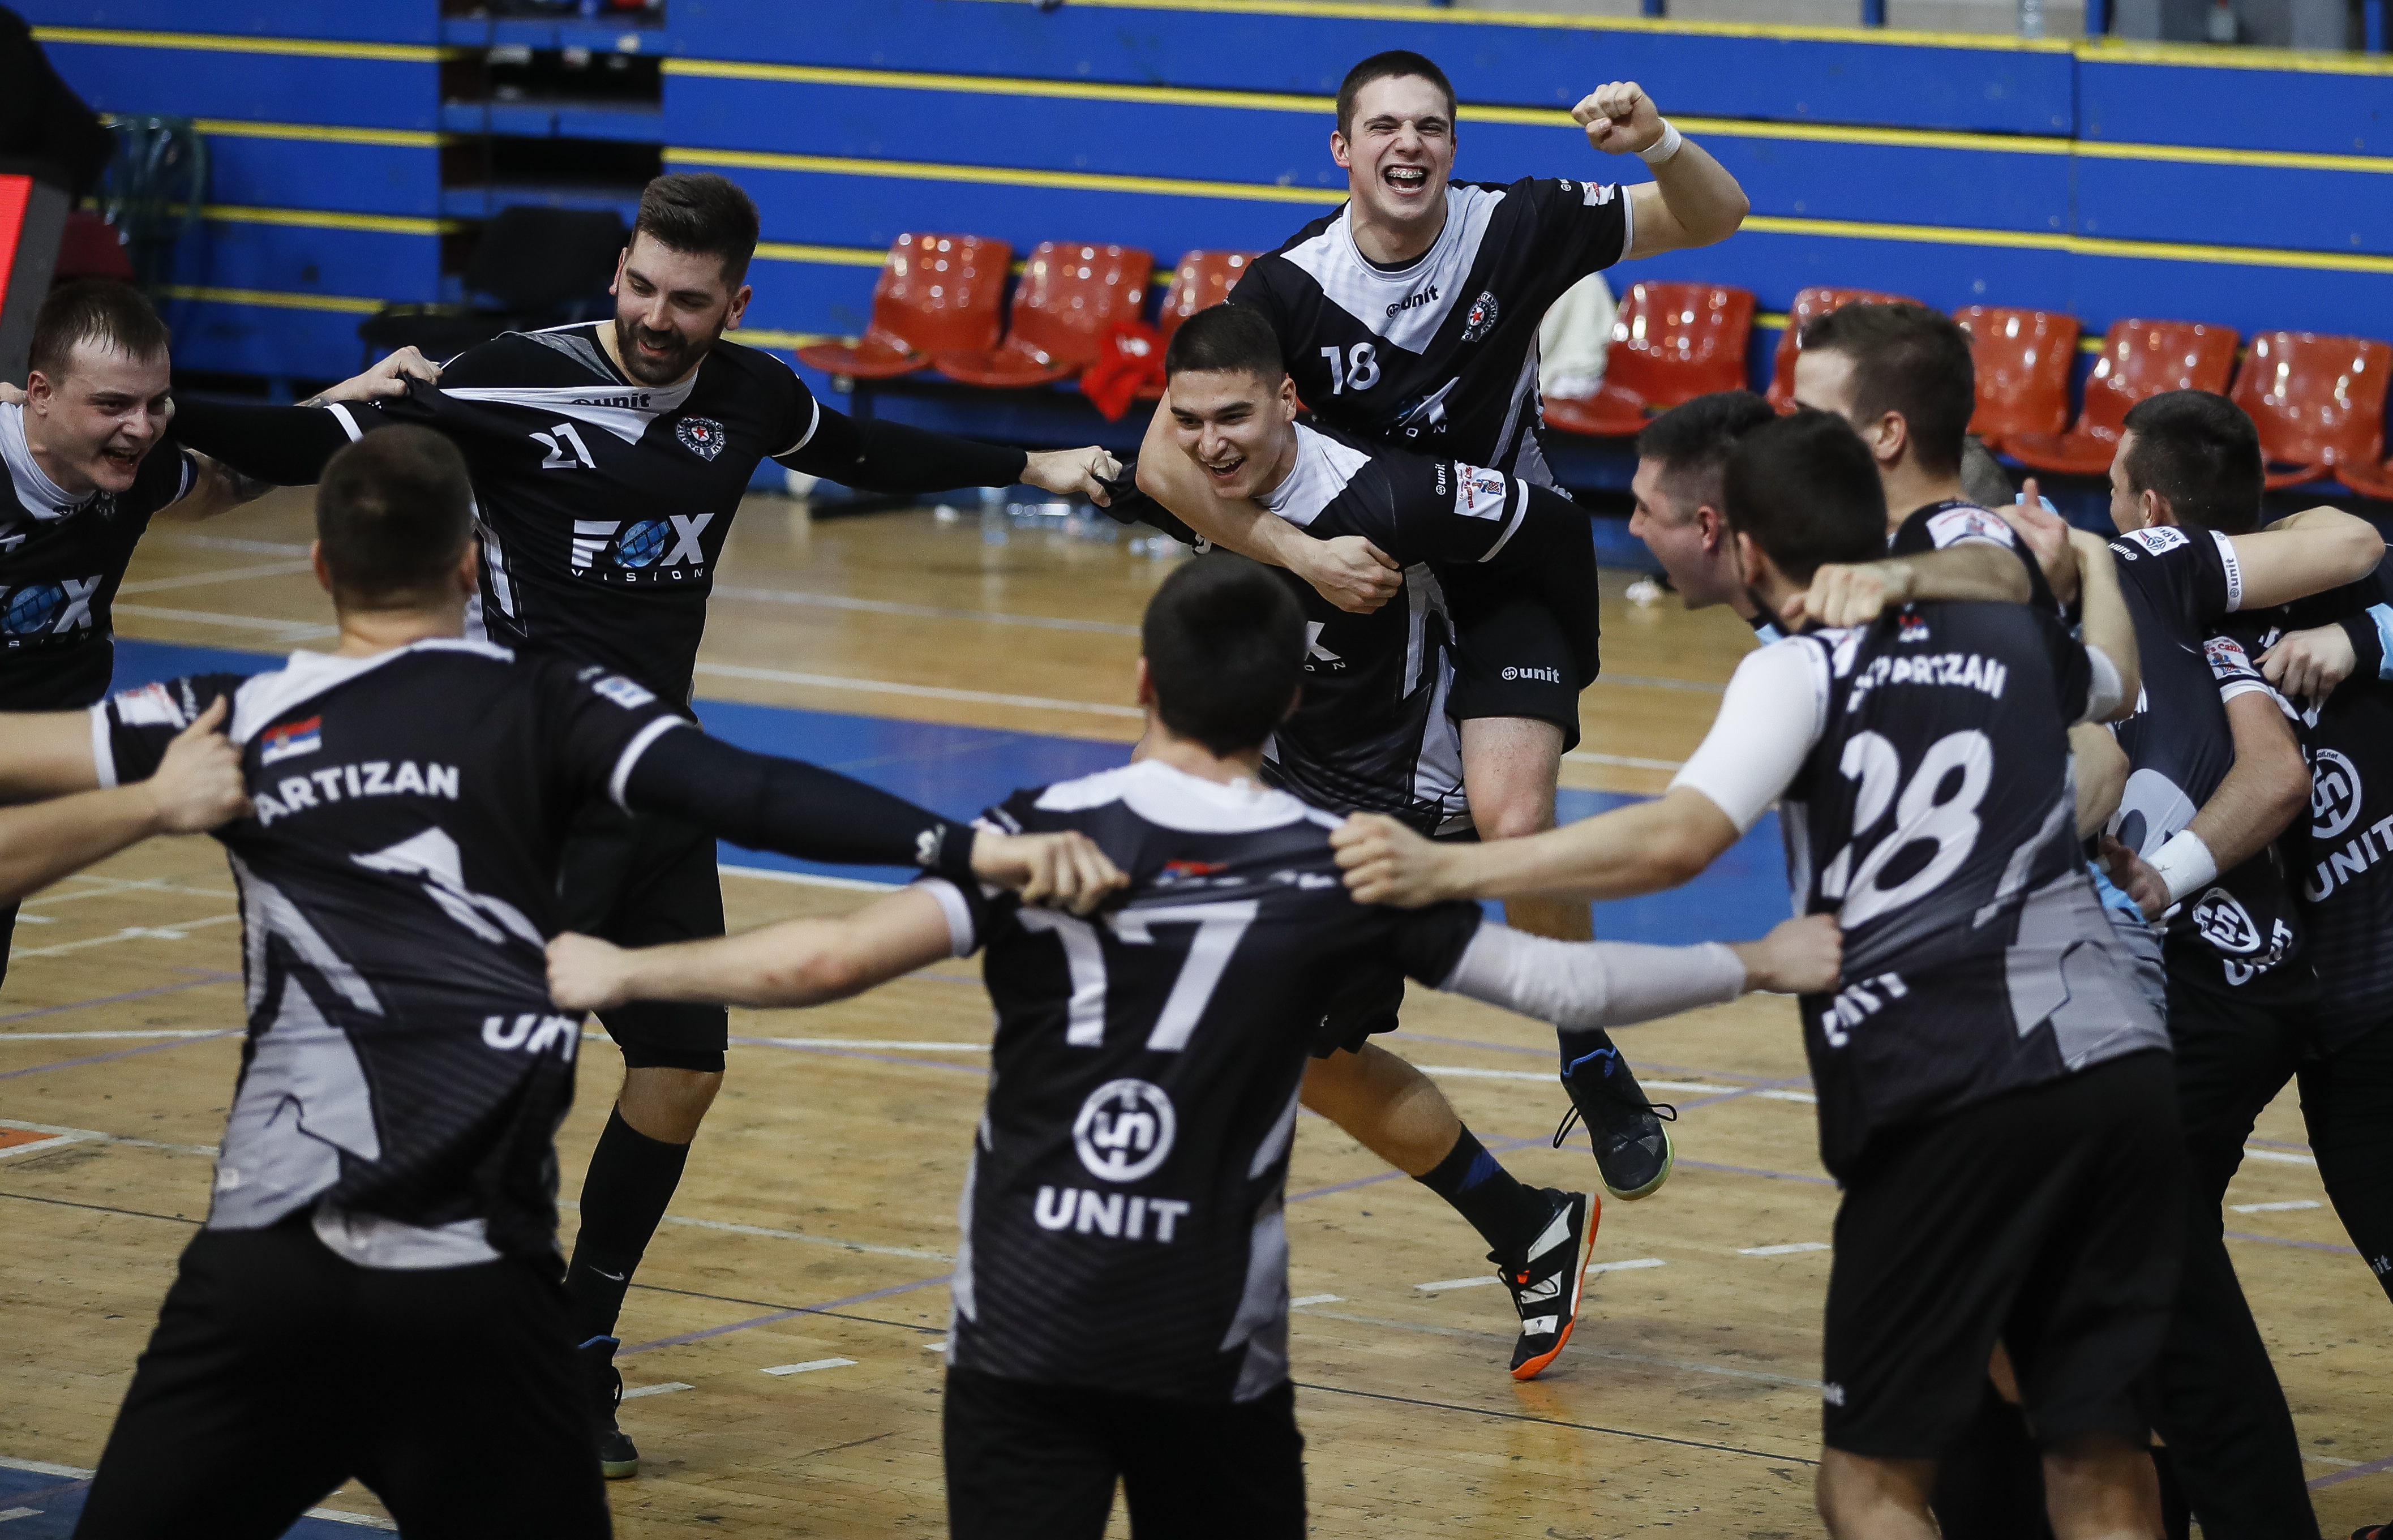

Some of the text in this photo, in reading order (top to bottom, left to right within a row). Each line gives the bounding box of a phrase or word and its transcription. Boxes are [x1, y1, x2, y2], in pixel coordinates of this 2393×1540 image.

[1401, 284, 1439, 310] unit
[1320, 342, 1381, 394] 18
[594, 393, 651, 408] unit
[529, 422, 597, 469] 21
[1435, 464, 1446, 484] unit
[572, 513, 715, 568] FOX
[571, 568, 704, 582] VISION
[2226, 557, 2239, 586] unit
[0, 574, 103, 634] OX
[1520, 667, 1560, 683] unit
[255, 760, 460, 828] ARTIZAN
[1821, 730, 1993, 930] 28
[2304, 814, 2393, 902] UNIT
[1019, 900, 1259, 1052] 17
[482, 1012, 580, 1063] UN
[1033, 1185, 1190, 1243] UNIT
